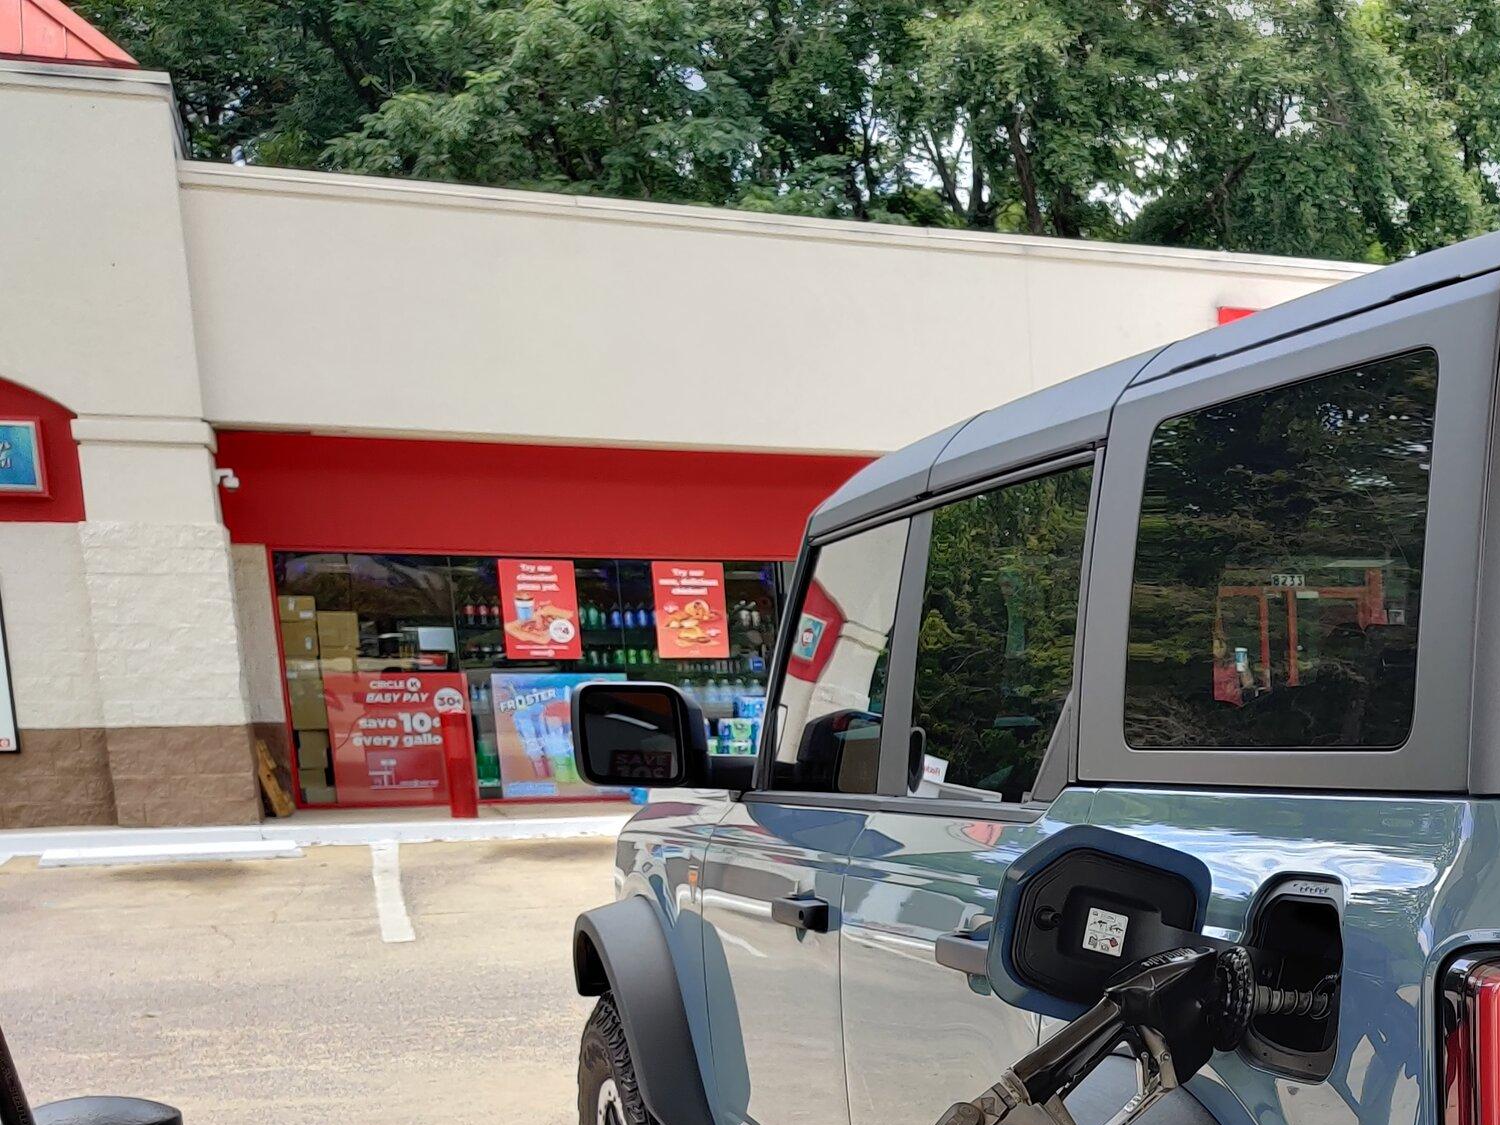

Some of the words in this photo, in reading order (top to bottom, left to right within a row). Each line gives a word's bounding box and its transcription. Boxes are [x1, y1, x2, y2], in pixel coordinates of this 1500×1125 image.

[369, 680, 405, 689] CIRCLE
[401, 692, 429, 703] PAY
[500, 689, 557, 714] FROSTER
[358, 717, 397, 729] save
[352, 735, 400, 748] every
[403, 733, 443, 748] gallo
